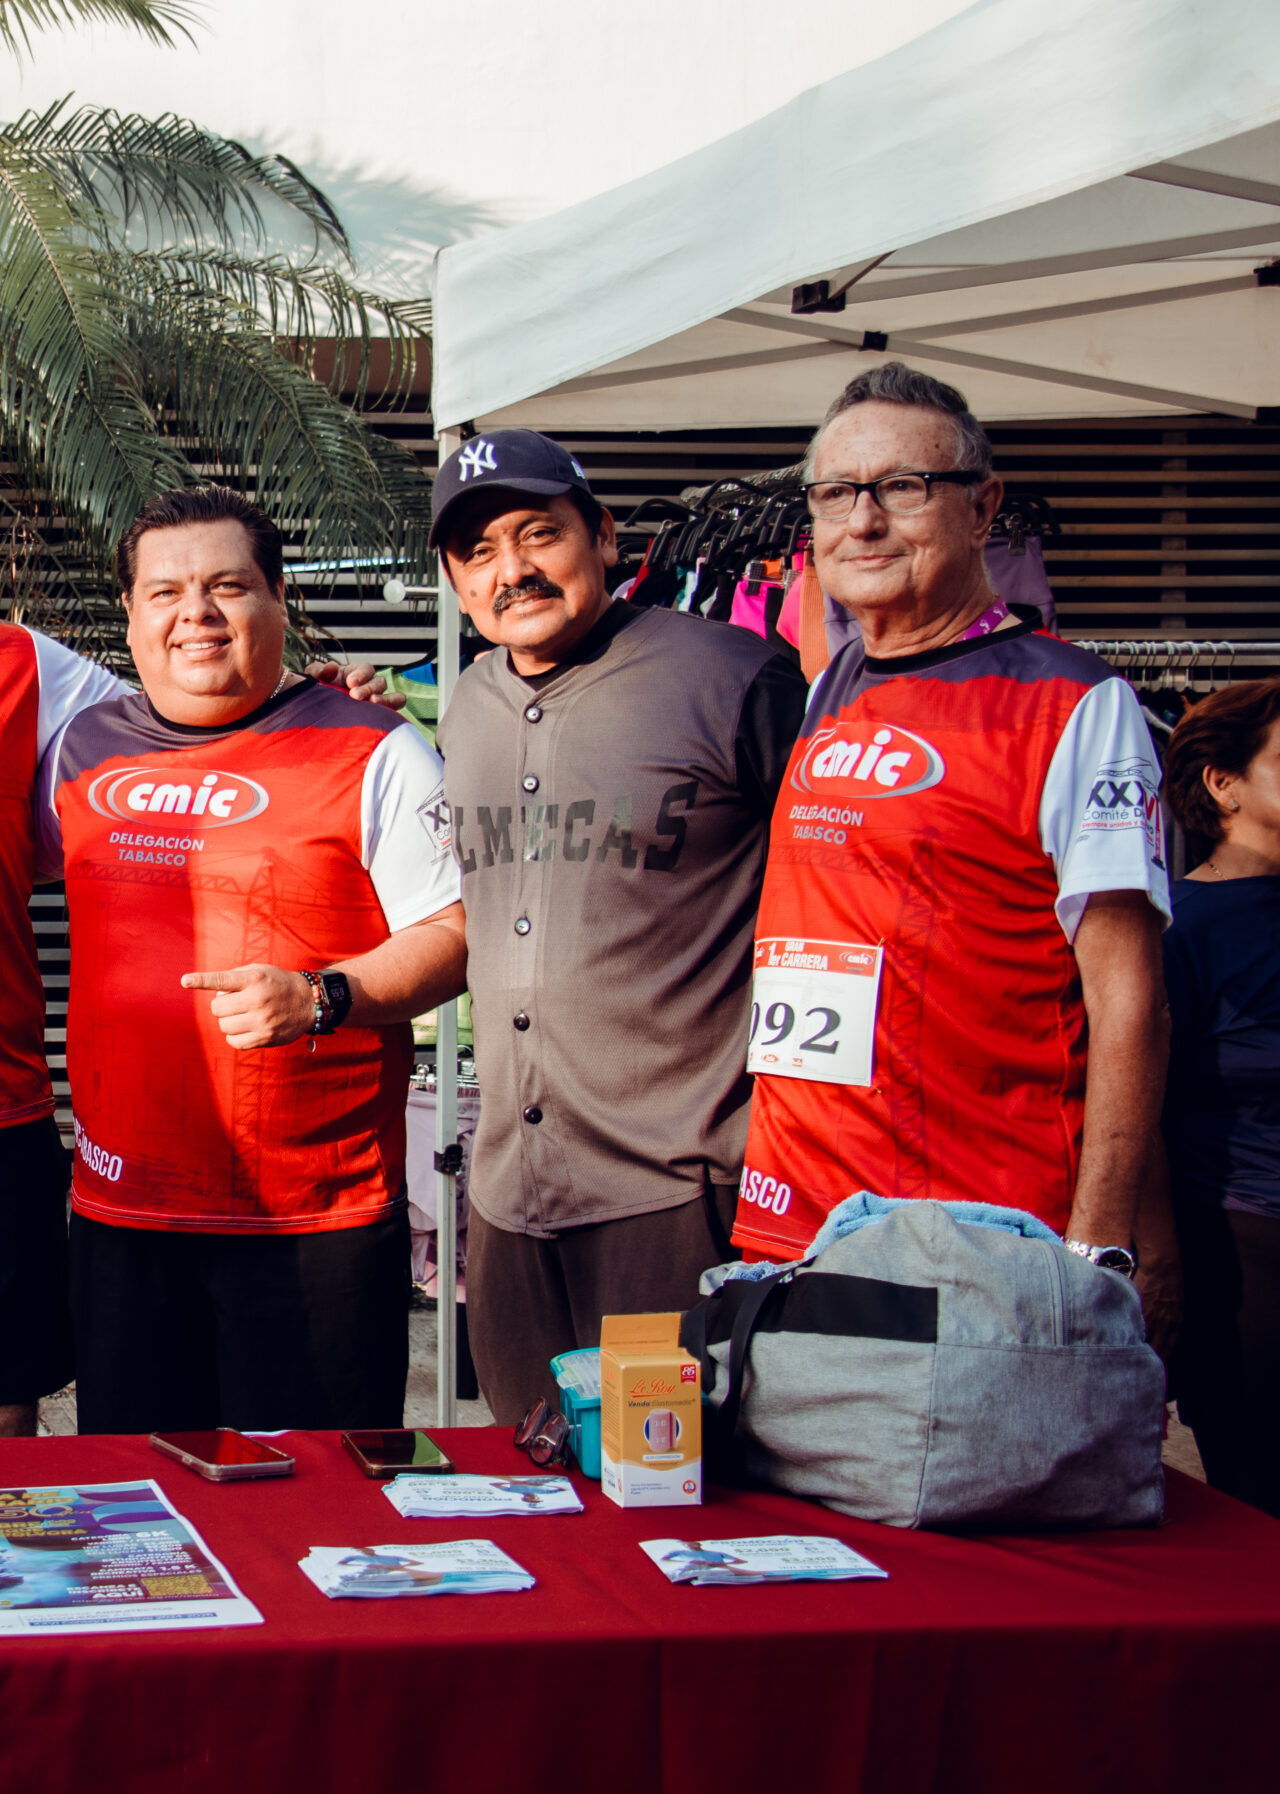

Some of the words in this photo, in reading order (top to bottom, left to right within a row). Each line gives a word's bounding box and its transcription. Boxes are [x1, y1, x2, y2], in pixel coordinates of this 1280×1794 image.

[458, 440, 497, 481] NY
[812, 729, 912, 787] cmic
[127, 774, 238, 818] cmic
[789, 804, 864, 827] DELEGACIÓN
[109, 831, 204, 852] DELEGACIÓN
[793, 825, 847, 845] TABASCO
[118, 848, 186, 867] TABASCO
[781, 952, 828, 970] CARRERA
